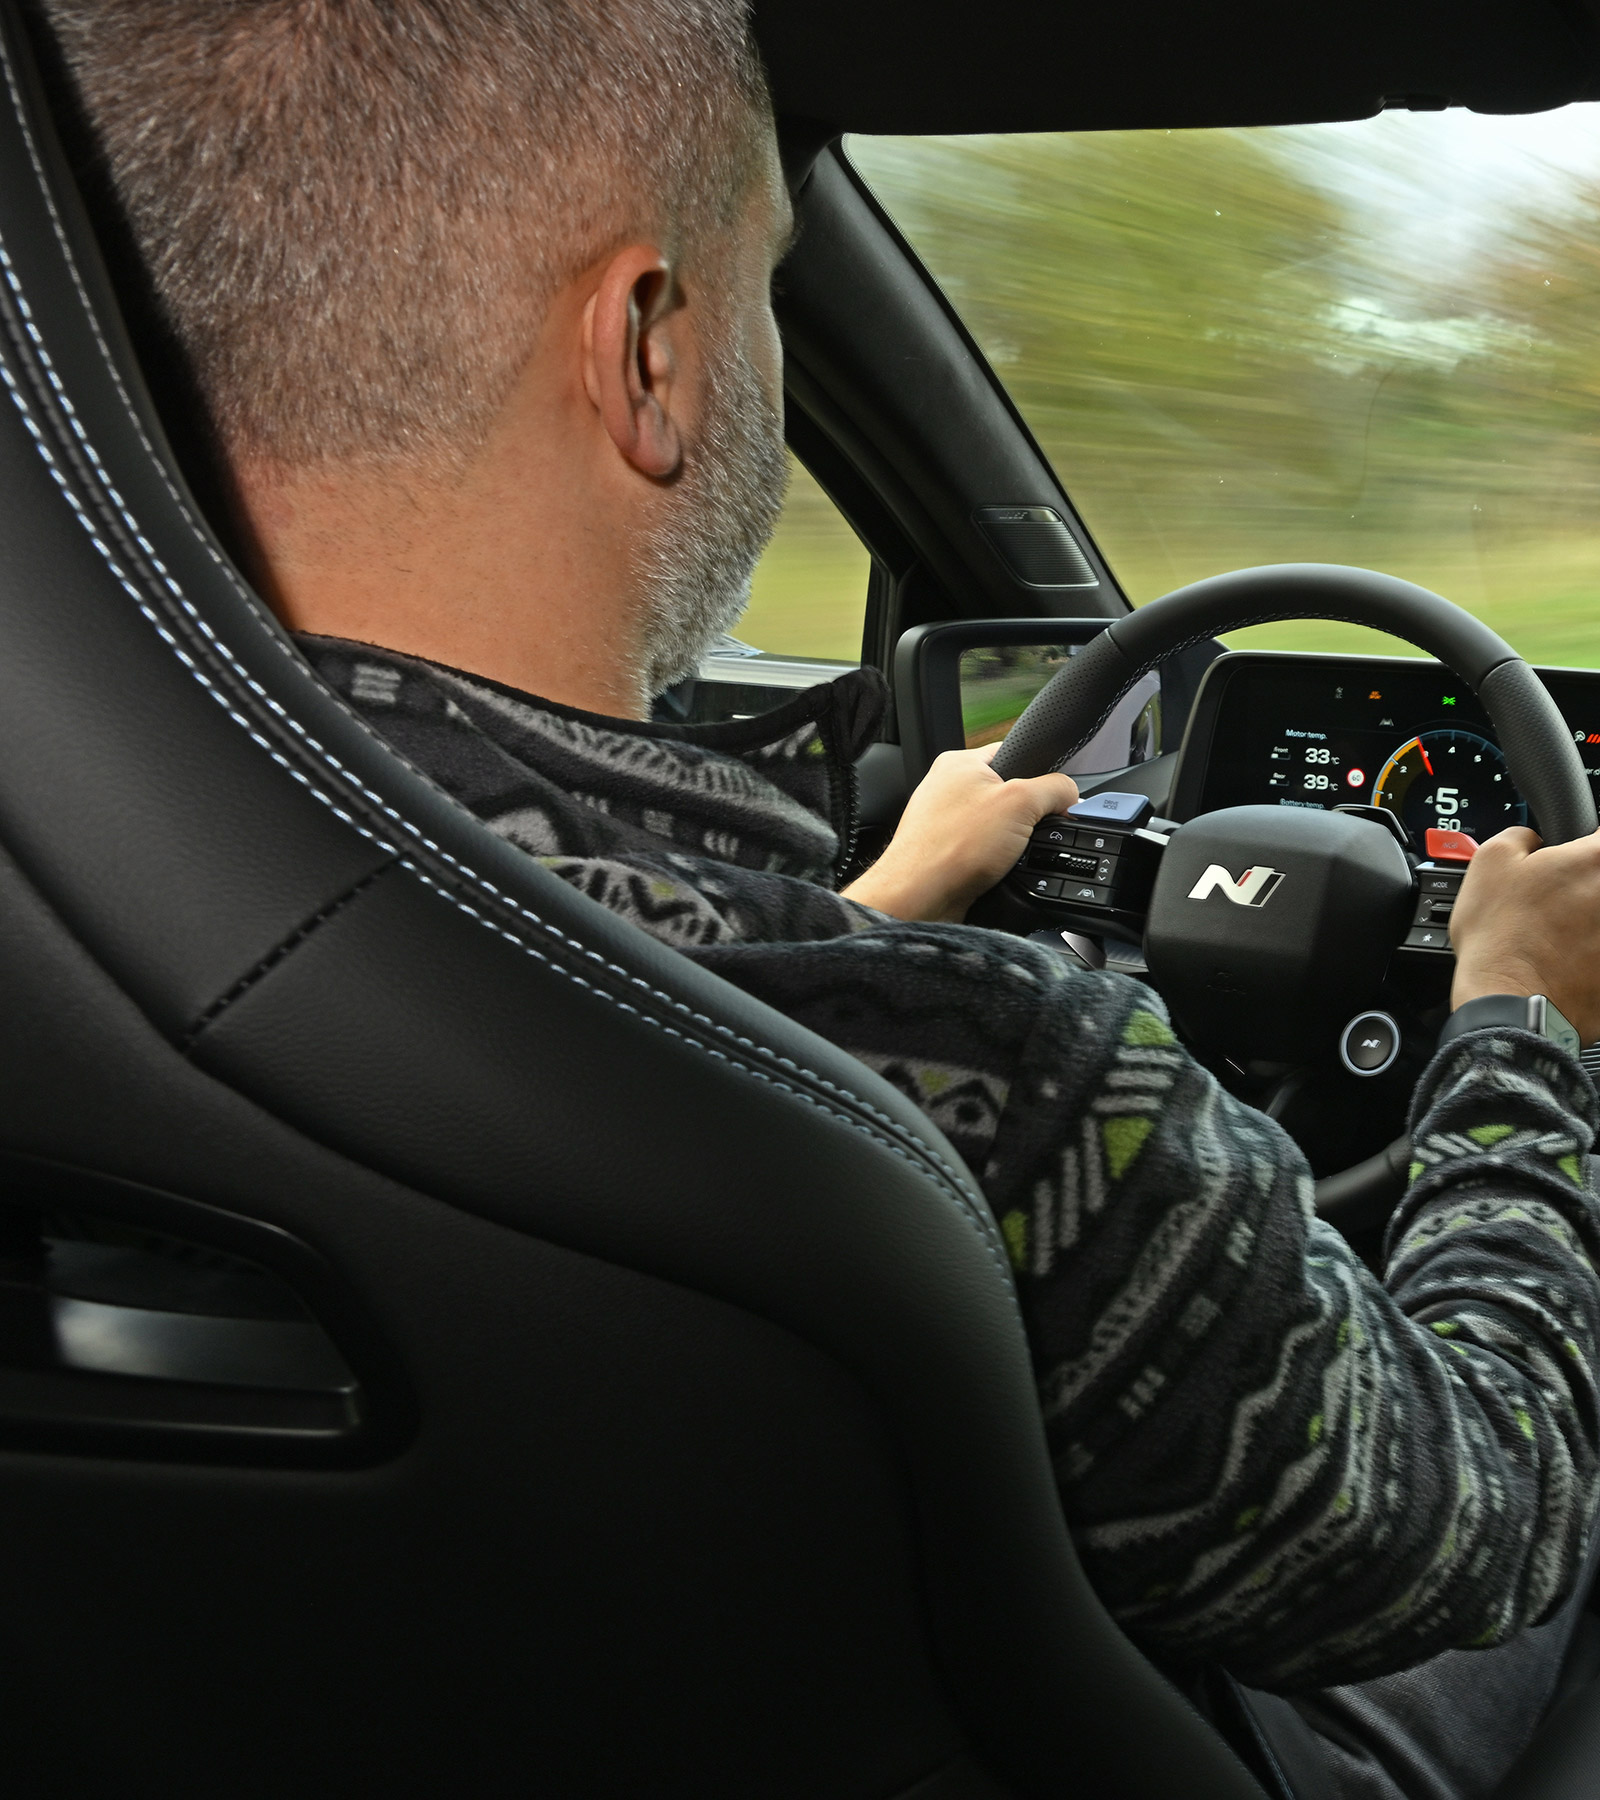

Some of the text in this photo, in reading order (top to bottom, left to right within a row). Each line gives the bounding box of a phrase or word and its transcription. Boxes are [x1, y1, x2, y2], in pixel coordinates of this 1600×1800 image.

[1285, 729, 1328, 740] Motor temp.
[1473, 754, 1482, 763] 5
[1399, 765, 1408, 774] 2
[1493, 773, 1502, 782] 6
[1280, 798, 1305, 807] Battery
[1424, 787, 1469, 815] 4 5 6
[1503, 803, 1512, 811] 7
[1437, 818, 1461, 832] 50
[1431, 881, 1448, 889] MODE
